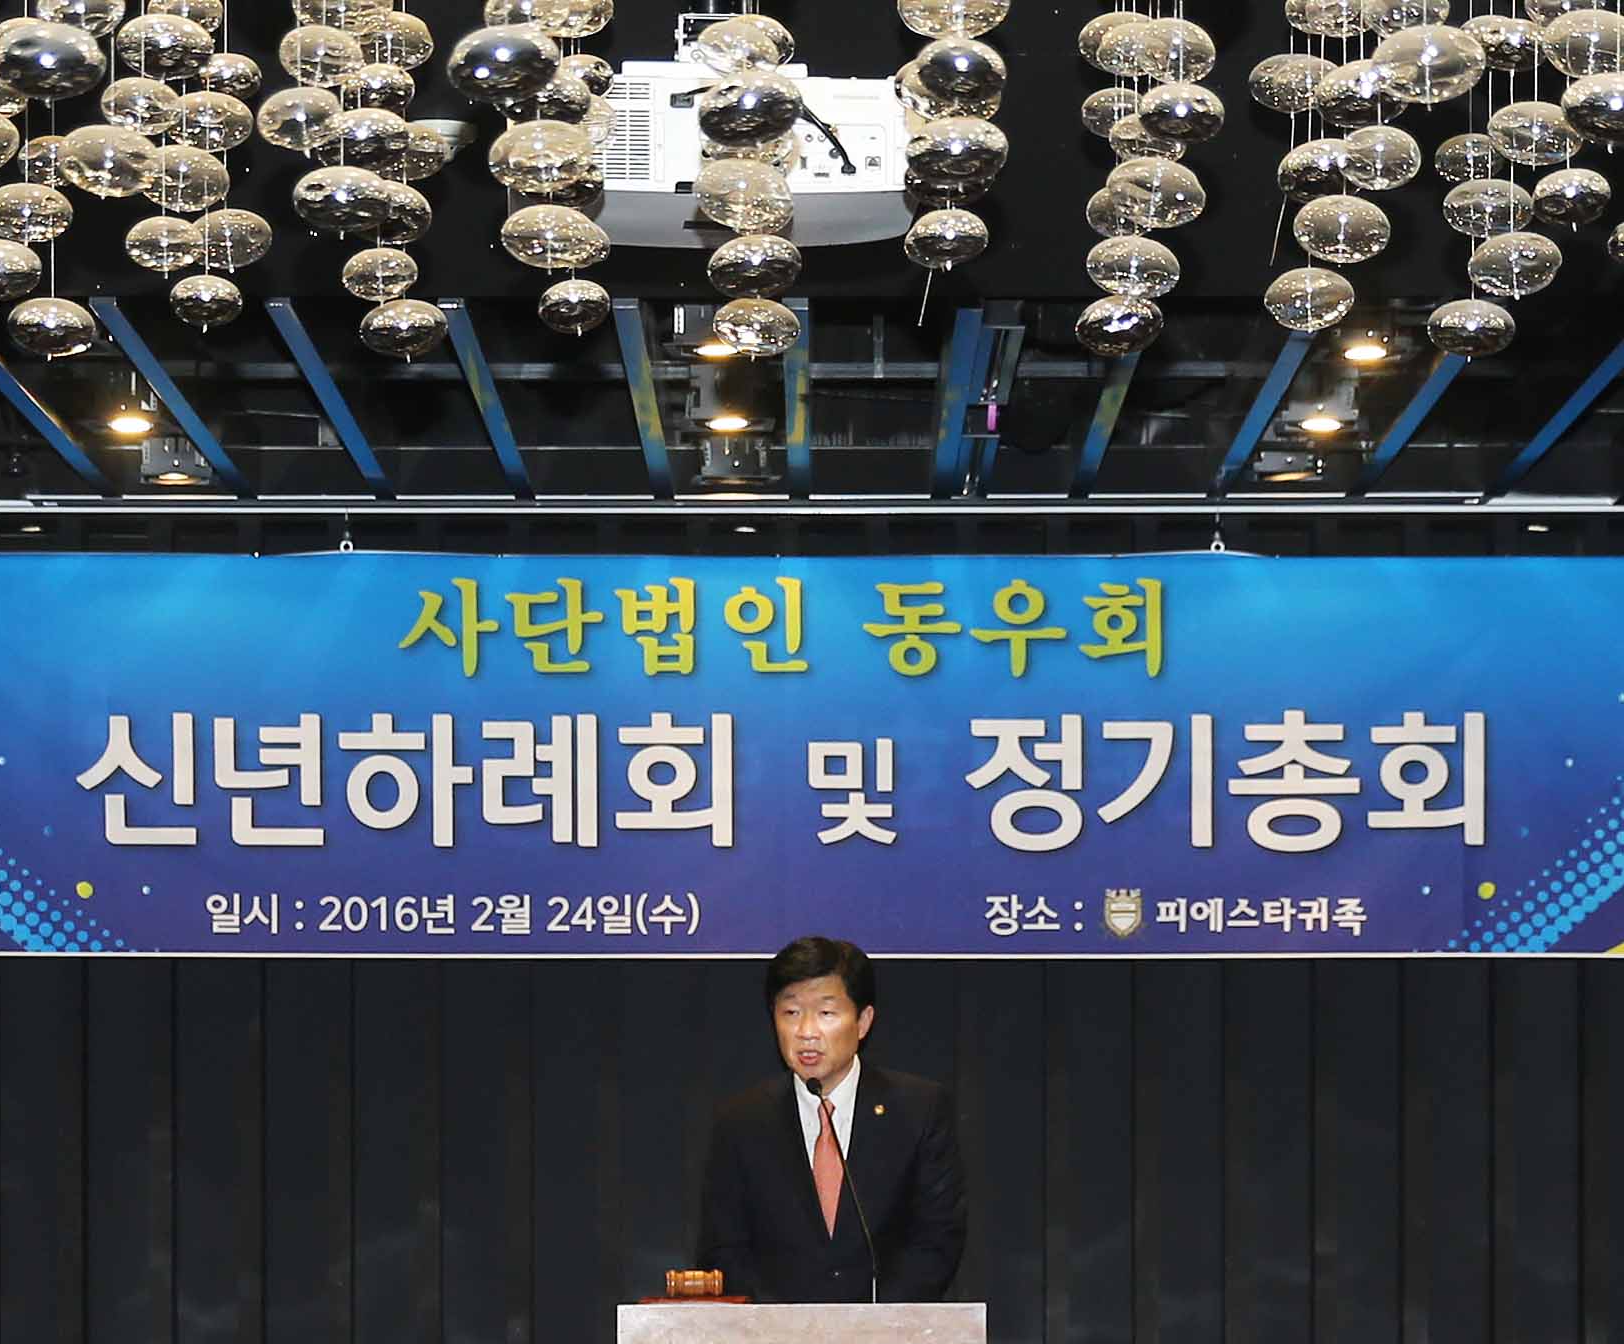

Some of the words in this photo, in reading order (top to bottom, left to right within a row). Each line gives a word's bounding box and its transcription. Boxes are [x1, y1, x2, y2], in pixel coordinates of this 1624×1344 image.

[399, 577, 809, 676] 사단법인
[864, 578, 1162, 676] 동우회
[76, 712, 733, 847] 신년하례회
[808, 738, 897, 844] 및
[965, 709, 1485, 852] 정기총회
[206, 893, 278, 934] 일시
[319, 894, 455, 934] 2016년
[471, 894, 531, 935] 2월
[546, 892, 700, 935] 24일(수)
[984, 894, 1061, 936] 장소
[1155, 896, 1367, 937] 피에스타귀족
